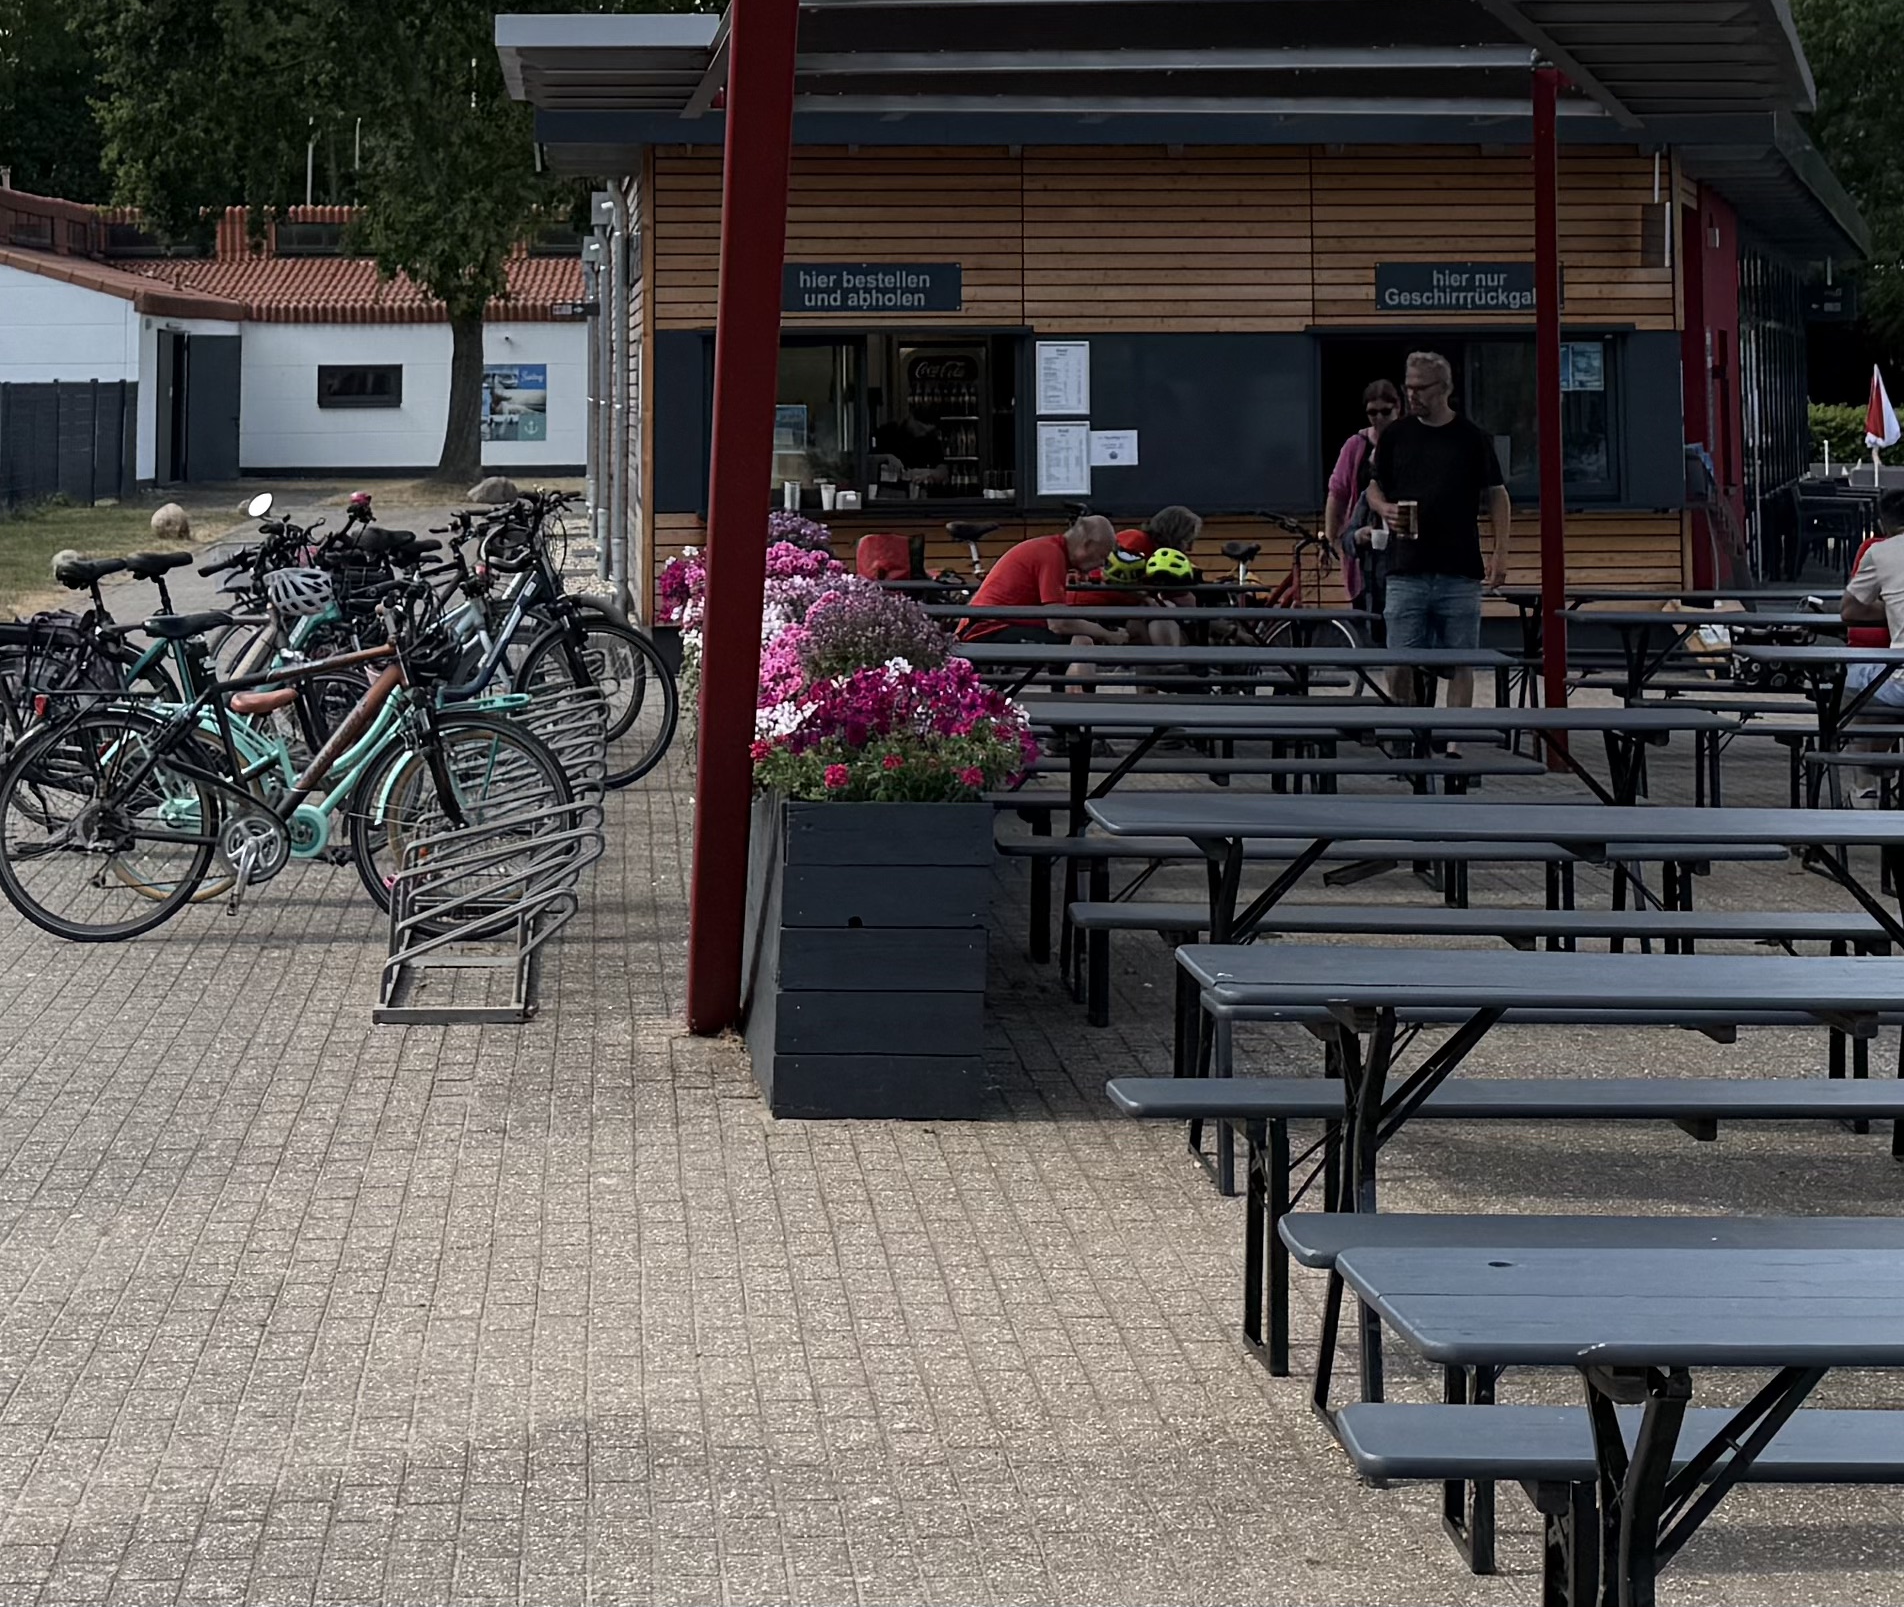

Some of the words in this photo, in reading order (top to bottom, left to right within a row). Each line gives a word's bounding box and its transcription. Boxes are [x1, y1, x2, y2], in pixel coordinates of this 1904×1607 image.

[799, 270, 837, 288] hier
[842, 270, 930, 288] bestellen
[1432, 270, 1470, 287] hier
[1475, 273, 1508, 287] nur
[804, 290, 841, 306] und
[847, 290, 925, 306] abholen
